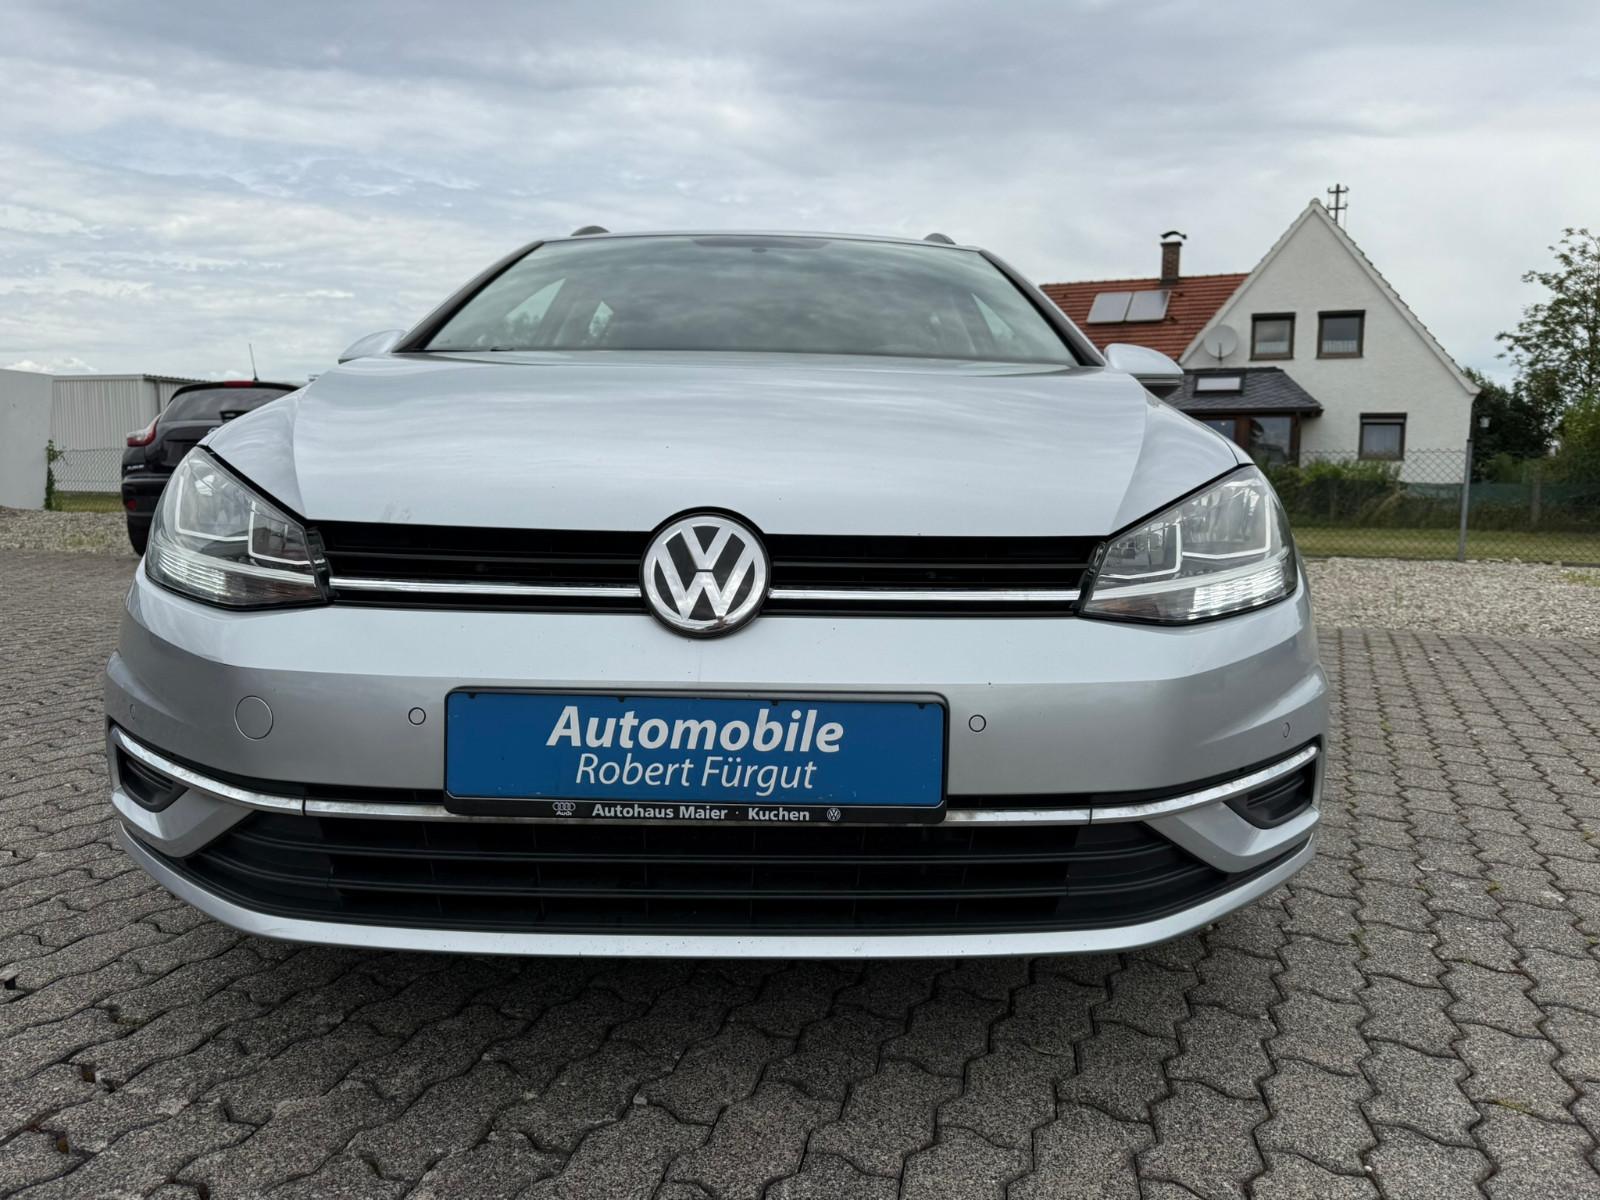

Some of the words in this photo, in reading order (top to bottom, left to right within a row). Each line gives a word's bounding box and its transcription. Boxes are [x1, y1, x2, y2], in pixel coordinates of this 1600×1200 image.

[644, 516, 766, 630] VW
[545, 705, 844, 753] Automobile
[575, 752, 694, 787] Robert
[701, 756, 817, 796] Fürgut
[592, 803, 674, 818] Autohaus
[679, 805, 728, 820] Maier
[748, 807, 810, 821] Kuchen
